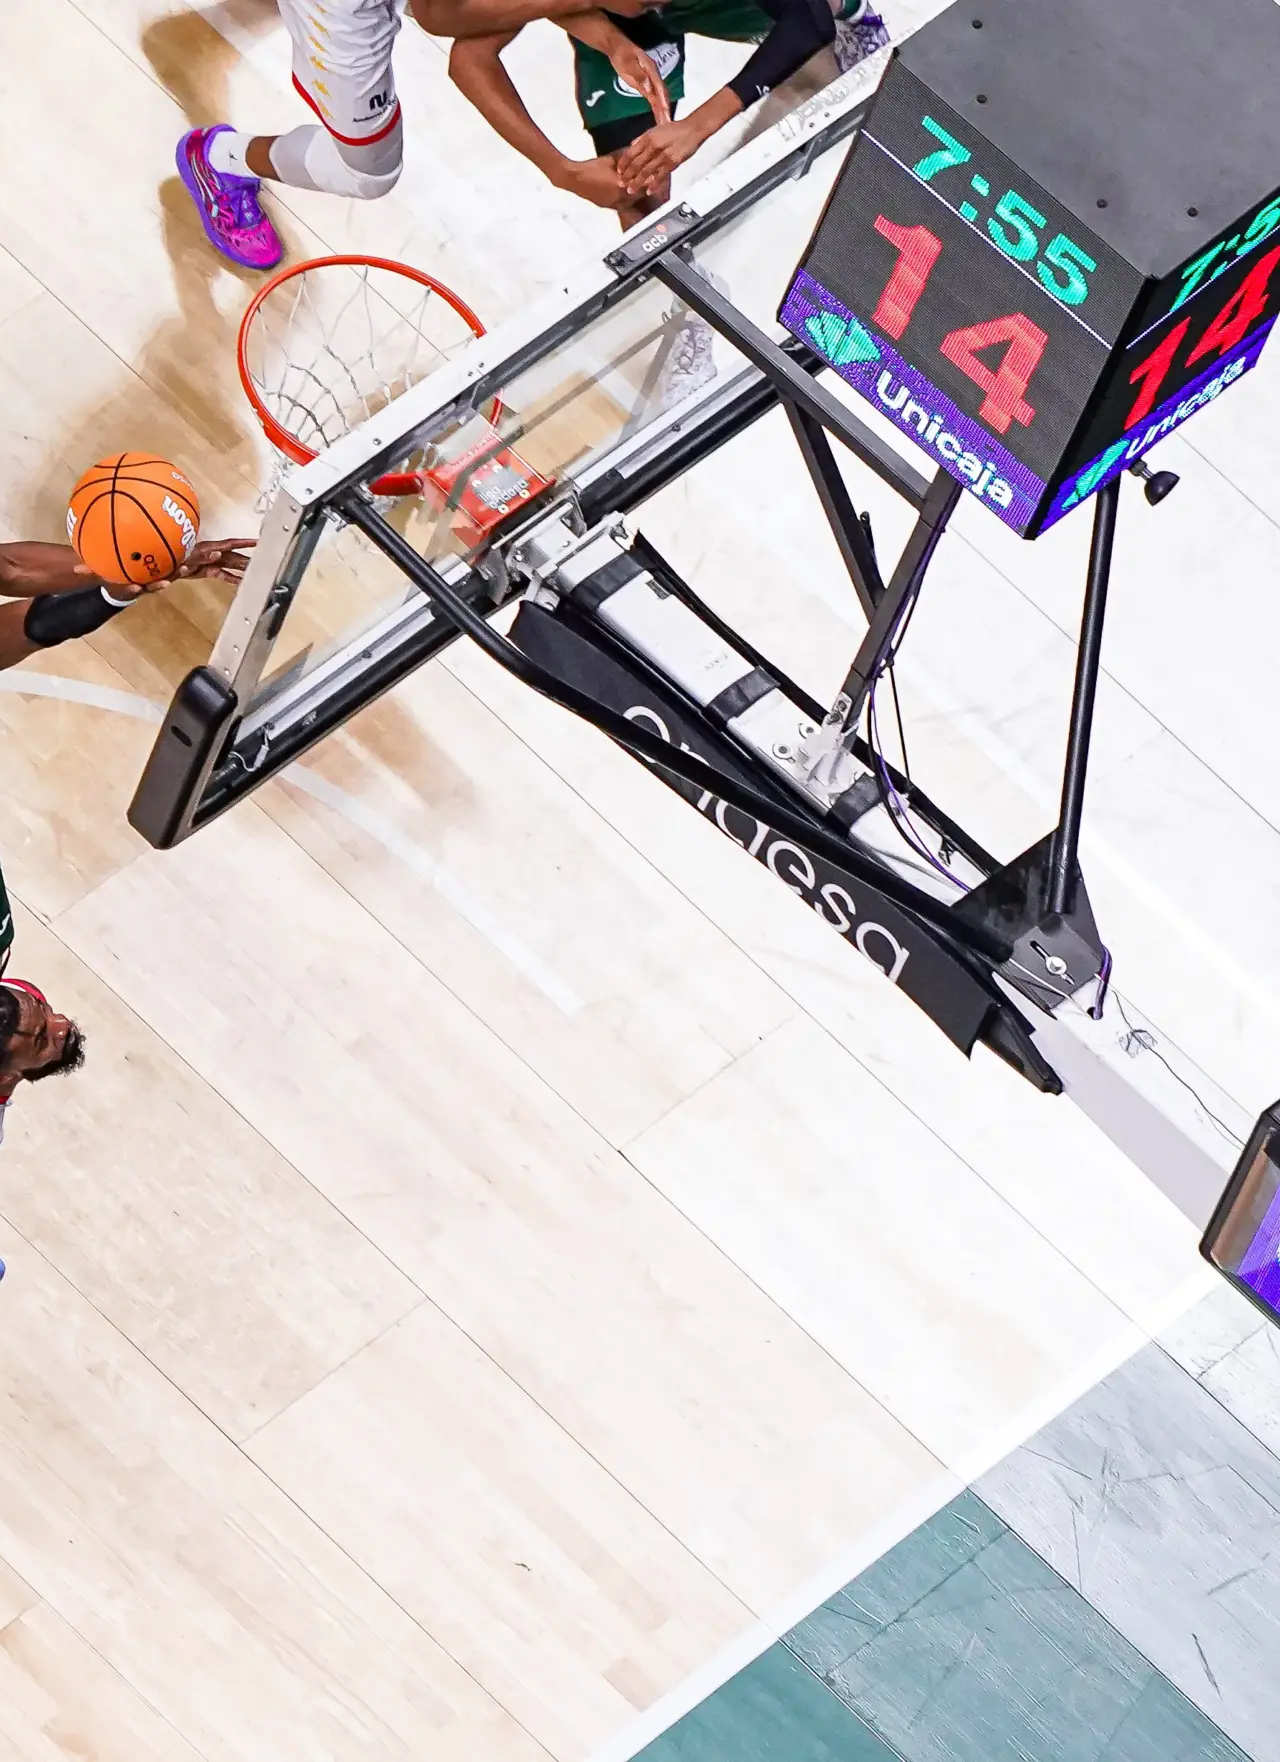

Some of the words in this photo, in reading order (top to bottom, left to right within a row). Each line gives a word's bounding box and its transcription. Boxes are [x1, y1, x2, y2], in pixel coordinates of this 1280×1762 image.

[641, 231, 669, 255] acb
[913, 115, 1098, 306] 7:55
[872, 213, 1048, 435] 14
[1123, 245, 1280, 431] 14
